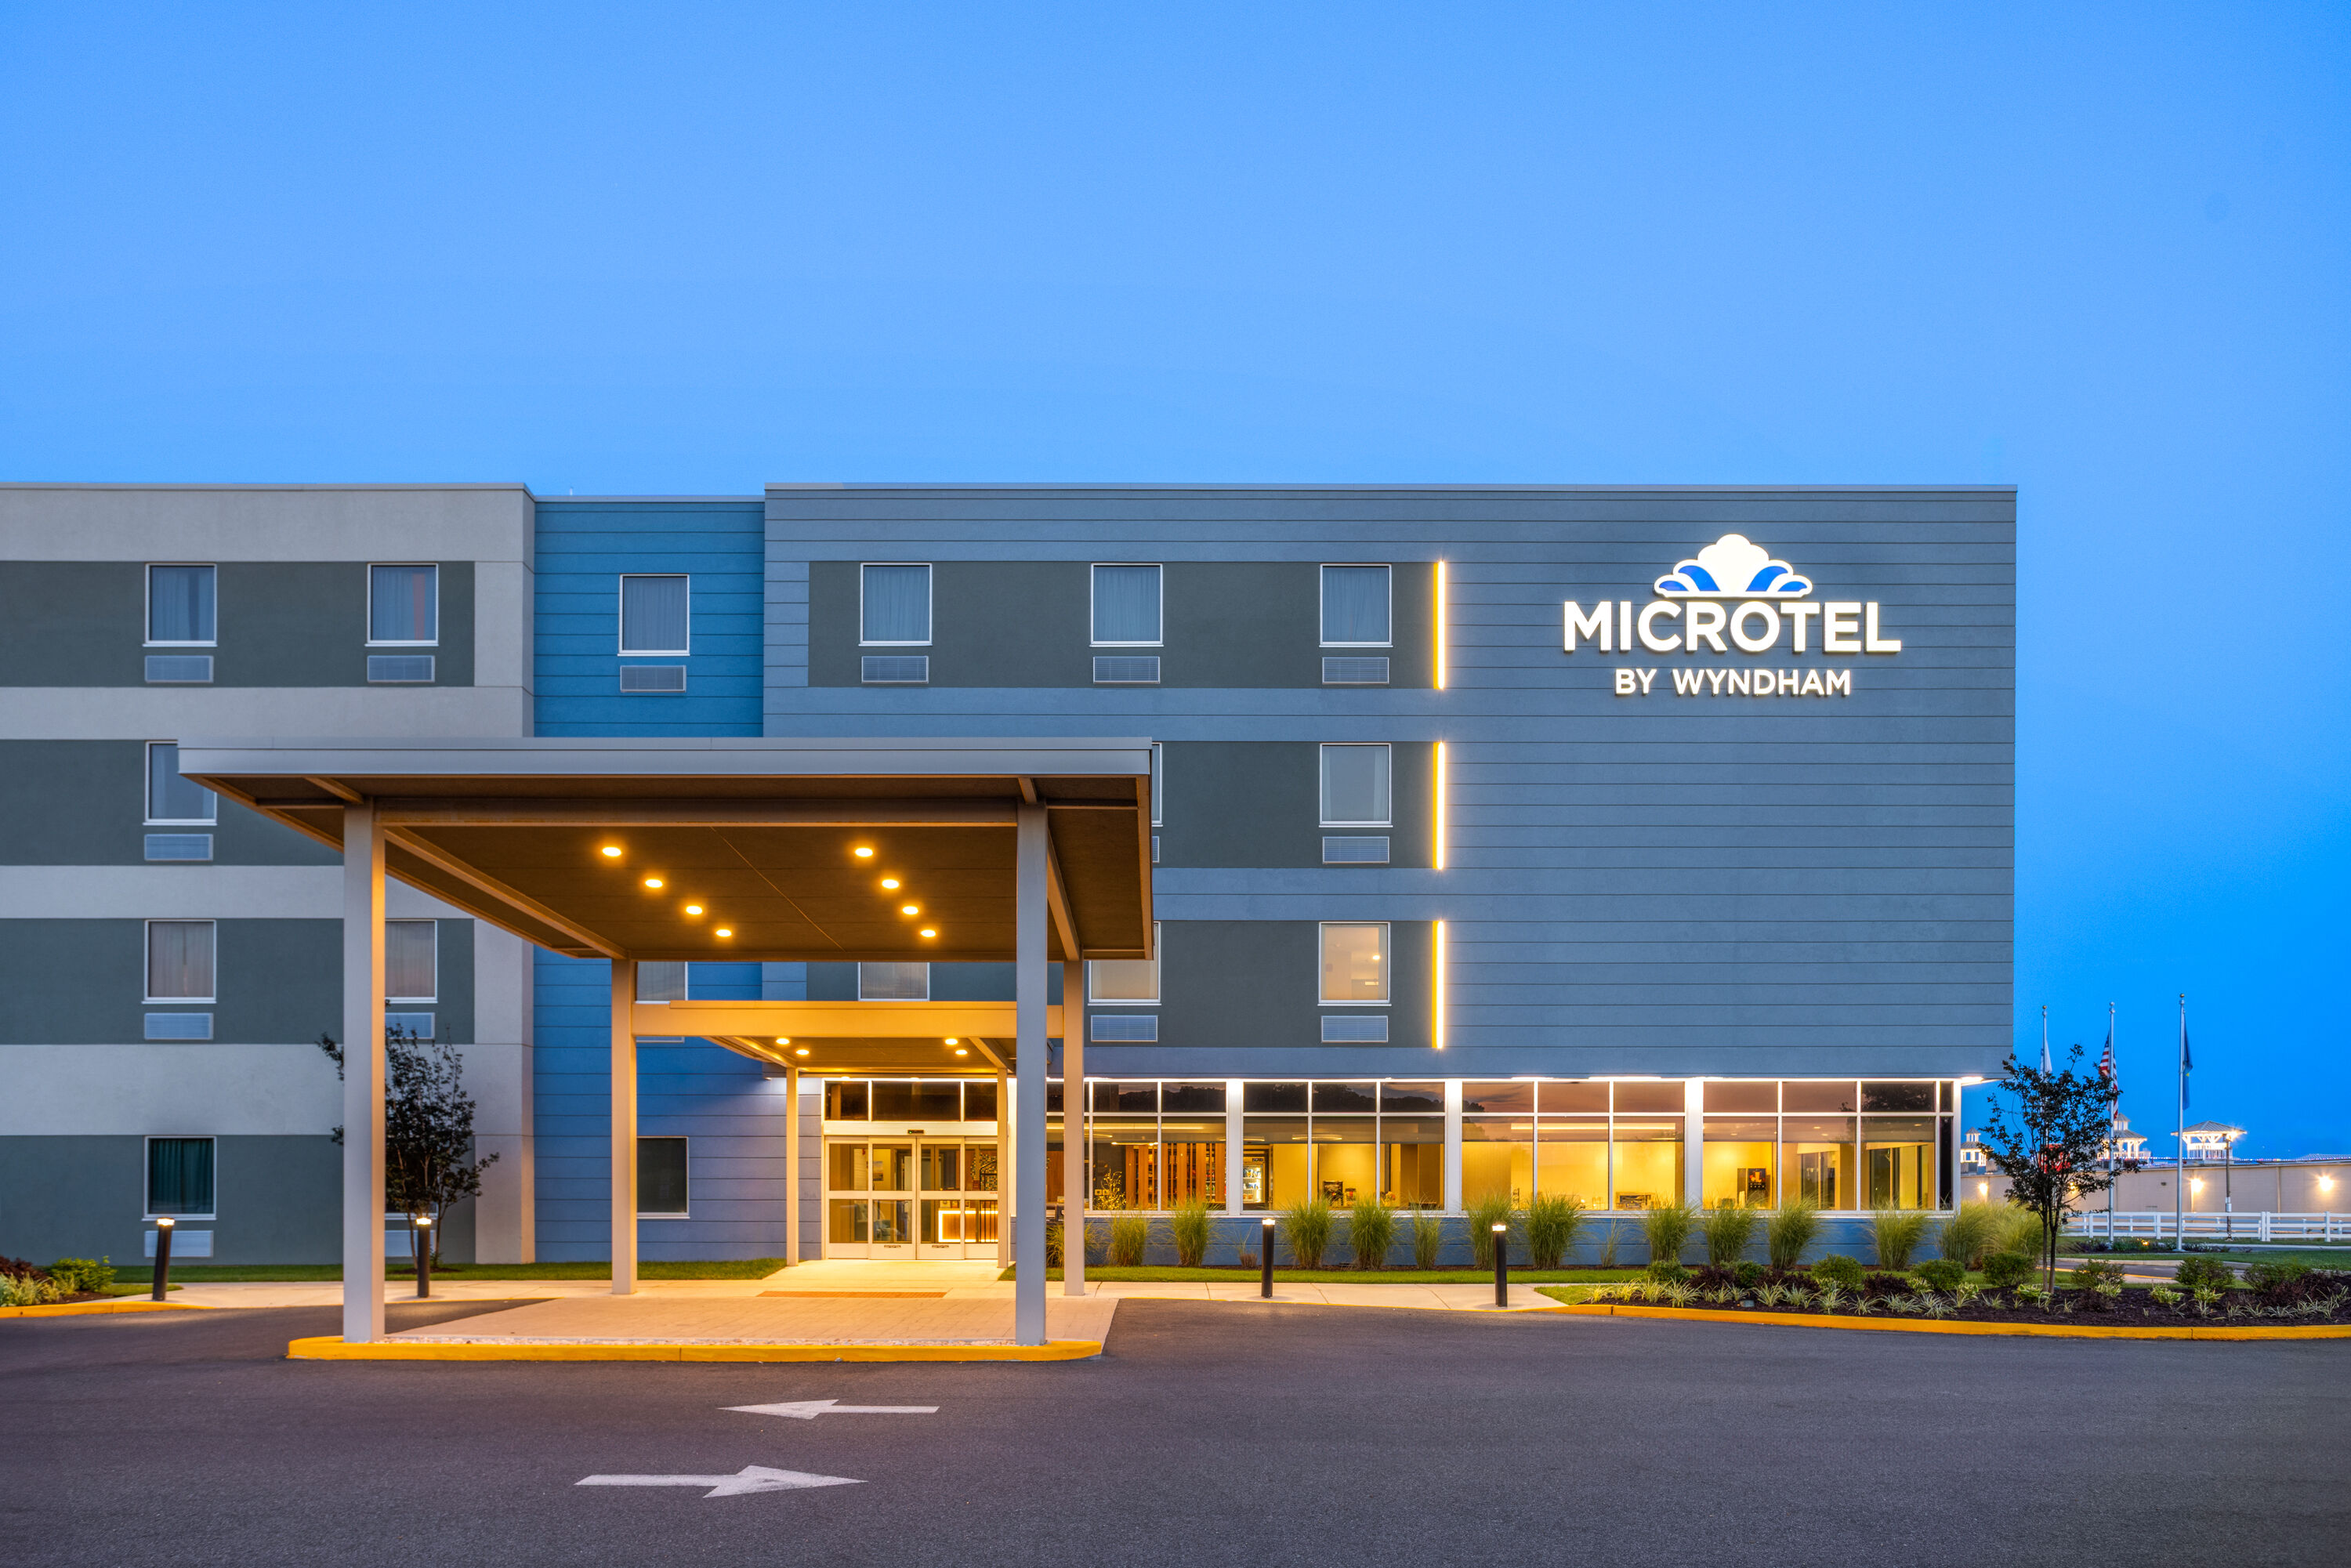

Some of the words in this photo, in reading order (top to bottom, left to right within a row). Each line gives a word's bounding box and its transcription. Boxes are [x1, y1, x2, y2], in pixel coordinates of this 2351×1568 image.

[1563, 600, 1902, 652] MICROTEL
[1615, 668, 1657, 695] BY
[1672, 668, 1850, 696] WYNDHAM
